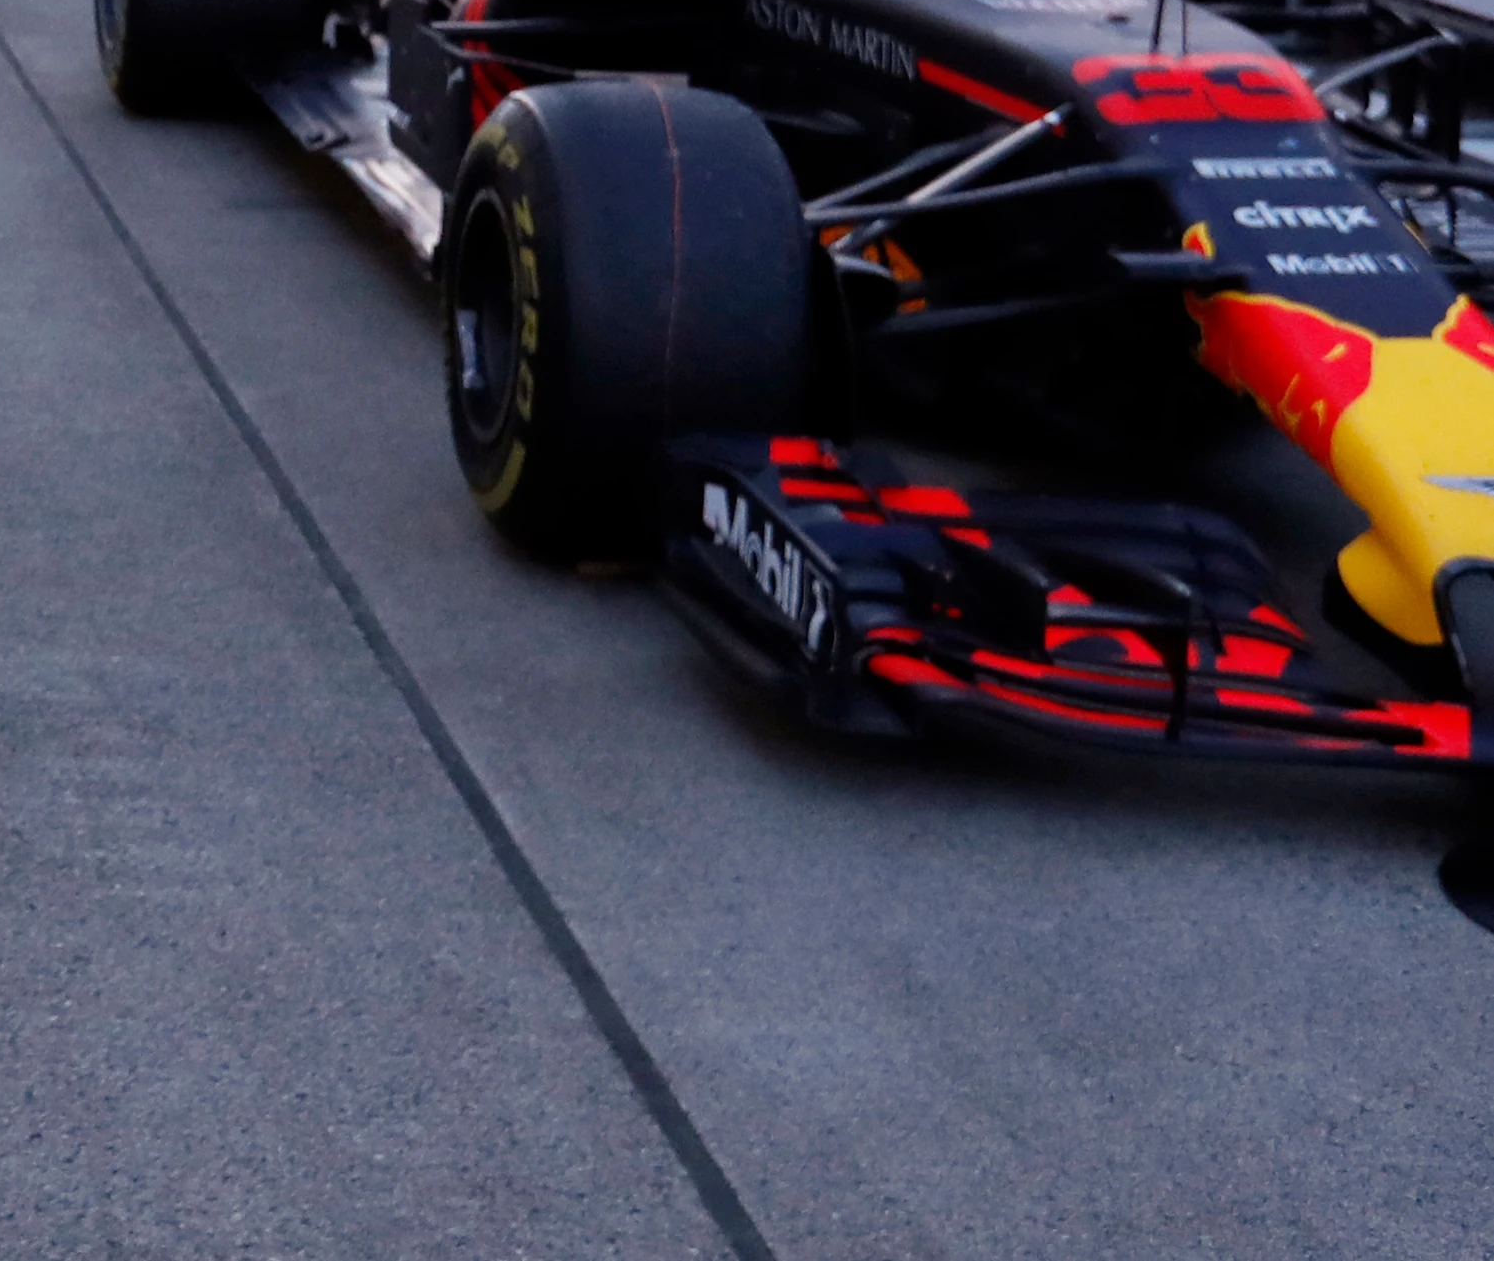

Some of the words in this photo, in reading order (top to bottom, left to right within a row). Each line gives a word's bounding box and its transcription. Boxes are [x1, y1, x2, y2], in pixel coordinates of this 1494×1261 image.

[828, 17, 915, 82] MARTIN
[1266, 251, 1379, 275] Mobil
[702, 480, 803, 622] Mobil
